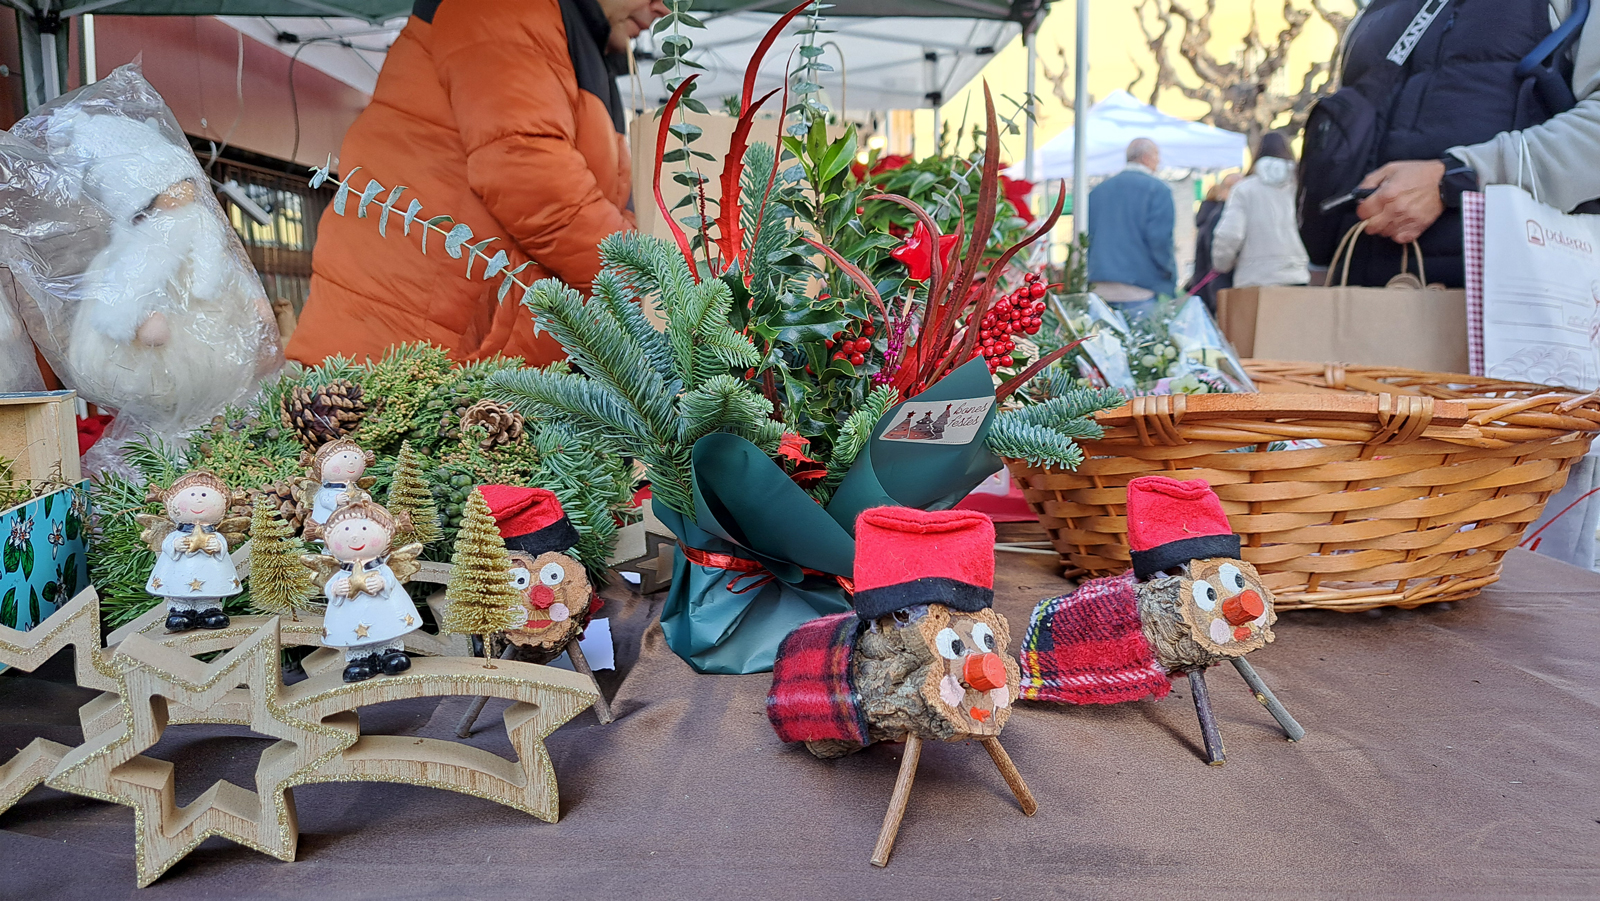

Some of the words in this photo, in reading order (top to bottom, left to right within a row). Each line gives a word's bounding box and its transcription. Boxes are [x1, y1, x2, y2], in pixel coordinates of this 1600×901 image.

[1389, 13, 1431, 62] KANI
[953, 402, 989, 415] bones
[947, 415, 980, 429] festes
